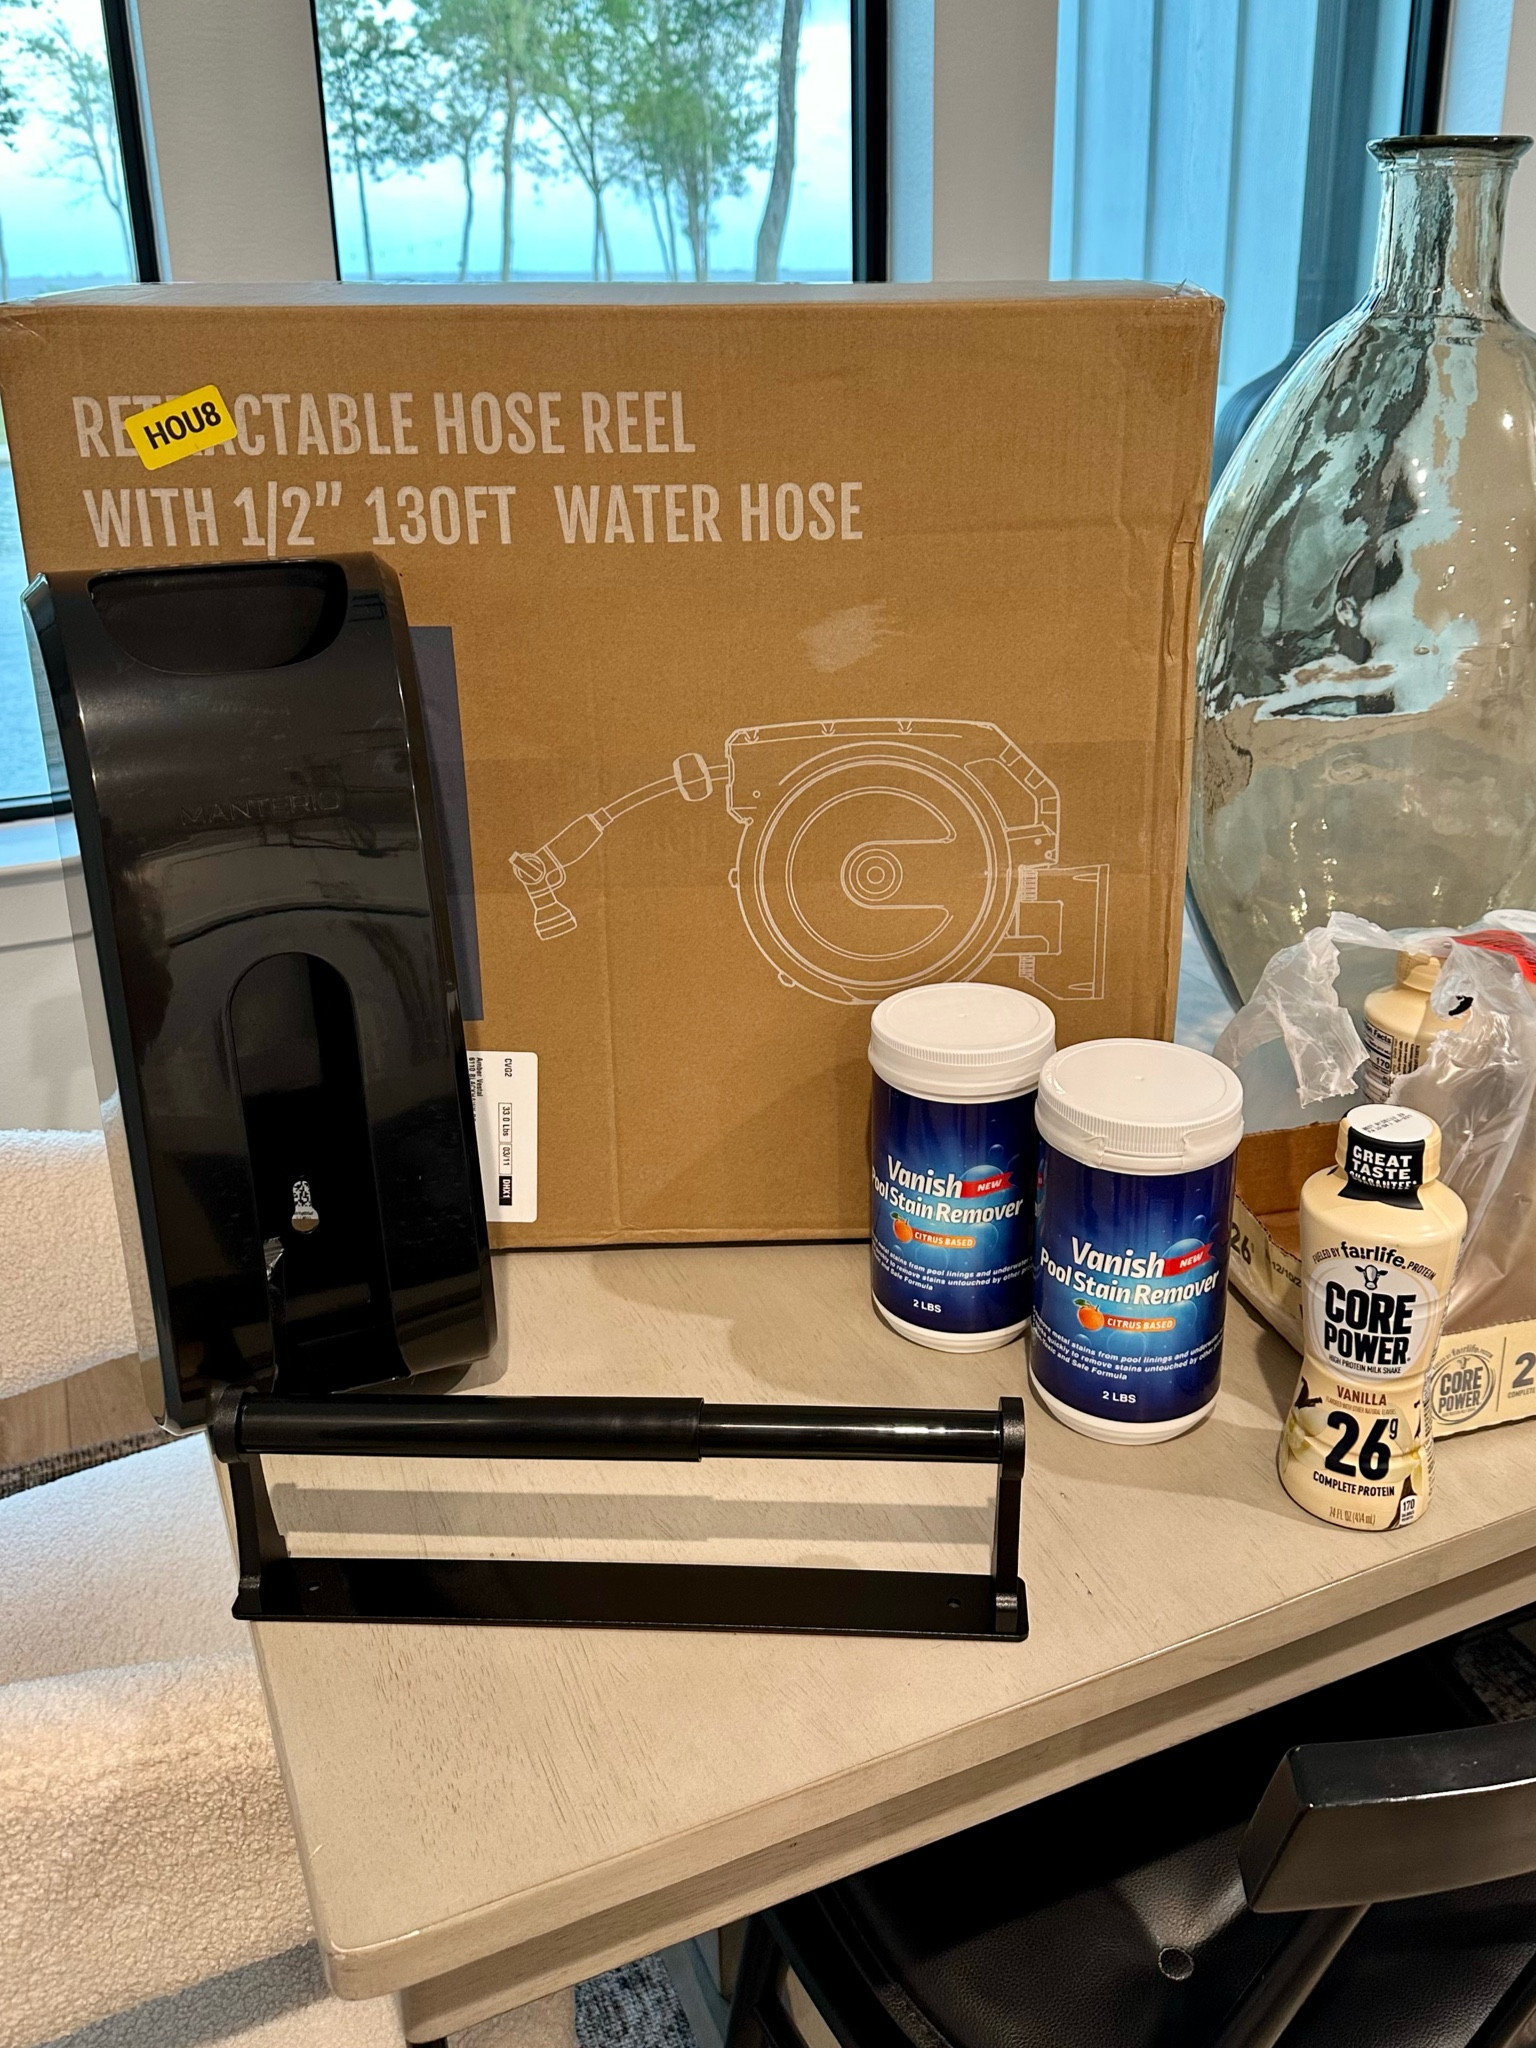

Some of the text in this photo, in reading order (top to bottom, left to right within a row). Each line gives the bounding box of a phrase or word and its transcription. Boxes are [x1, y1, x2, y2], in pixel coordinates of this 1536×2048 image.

[72, 390, 695, 458] RECTABLE HOSE REEL
[143, 401, 222, 450] HOU8
[82, 487, 216, 548] WITH
[364, 486, 516, 547] 130FT
[554, 483, 719, 544] WATER
[742, 482, 862, 541] HOSE
[504, 1058, 513, 1078] CVG2
[1376, 1057, 1391, 1069] 170
[476, 1057, 484, 1097] Amber Vestal
[502, 1124, 511, 1137] Lbs
[502, 1147, 511, 1166] 03/11
[1352, 1144, 1413, 1168] GREAT
[887, 1154, 963, 1199] Vanish
[1352, 1158, 1412, 1180] TASTE
[502, 1178, 511, 1199] DHX1
[977, 1178, 1003, 1192] NEW
[890, 1187, 932, 1220] Stain
[936, 1199, 1024, 1224] Remover
[914, 1231, 973, 1247] CITRUS BASED
[1071, 1237, 1165, 1279] Vanish
[1179, 1252, 1204, 1269] NEW
[1312, 1248, 1331, 1264] FUELED
[1331, 1247, 1341, 1257] BY
[1406, 1261, 1437, 1281] PROTEIN
[896, 1265, 921, 1279] remove
[922, 1275, 946, 1285] stains
[947, 1278, 990, 1286] untouched
[992, 1276, 1001, 1285] by
[908, 1261, 925, 1272] from
[926, 1268, 945, 1276] pool
[946, 1270, 974, 1279] linings
[975, 1269, 991, 1278] and
[1041, 1247, 1220, 1305] Pool Stain Remover
[904, 1276, 933, 1291] Formula
[913, 1299, 942, 1313] 2 LBS
[1325, 1280, 1417, 1335] CORE
[1107, 1318, 1174, 1330] CITRUS BASED
[1051, 1330, 1071, 1345] metal
[1071, 1341, 1096, 1356] stains
[1098, 1350, 1119, 1361] from
[1120, 1355, 1141, 1363] pool
[1143, 1355, 1172, 1364] linings
[1174, 1350, 1189, 1360] and
[1057, 1352, 1070, 1363] and
[1071, 1359, 1090, 1372] Safe
[1091, 1366, 1128, 1380] Formula
[1071, 1350, 1080, 1358] to
[1081, 1355, 1112, 1369] remove
[1115, 1363, 1141, 1372] stains
[1144, 1360, 1188, 1372] untouched
[1189, 1357, 1199, 1365] by
[1328, 1354, 1402, 1374] HIGH PROTEIN MILK SHAKE
[1440, 1366, 1483, 1396] CORE
[1102, 1391, 1137, 1404] 2 LBS
[1336, 1384, 1387, 1406] VANILLA
[1438, 1390, 1481, 1414] POWER
[1507, 1387, 1536, 1399] COMPLETE
[1313, 1470, 1395, 1497] COMPLETE PROTEIN
[1402, 1498, 1415, 1511] 170
